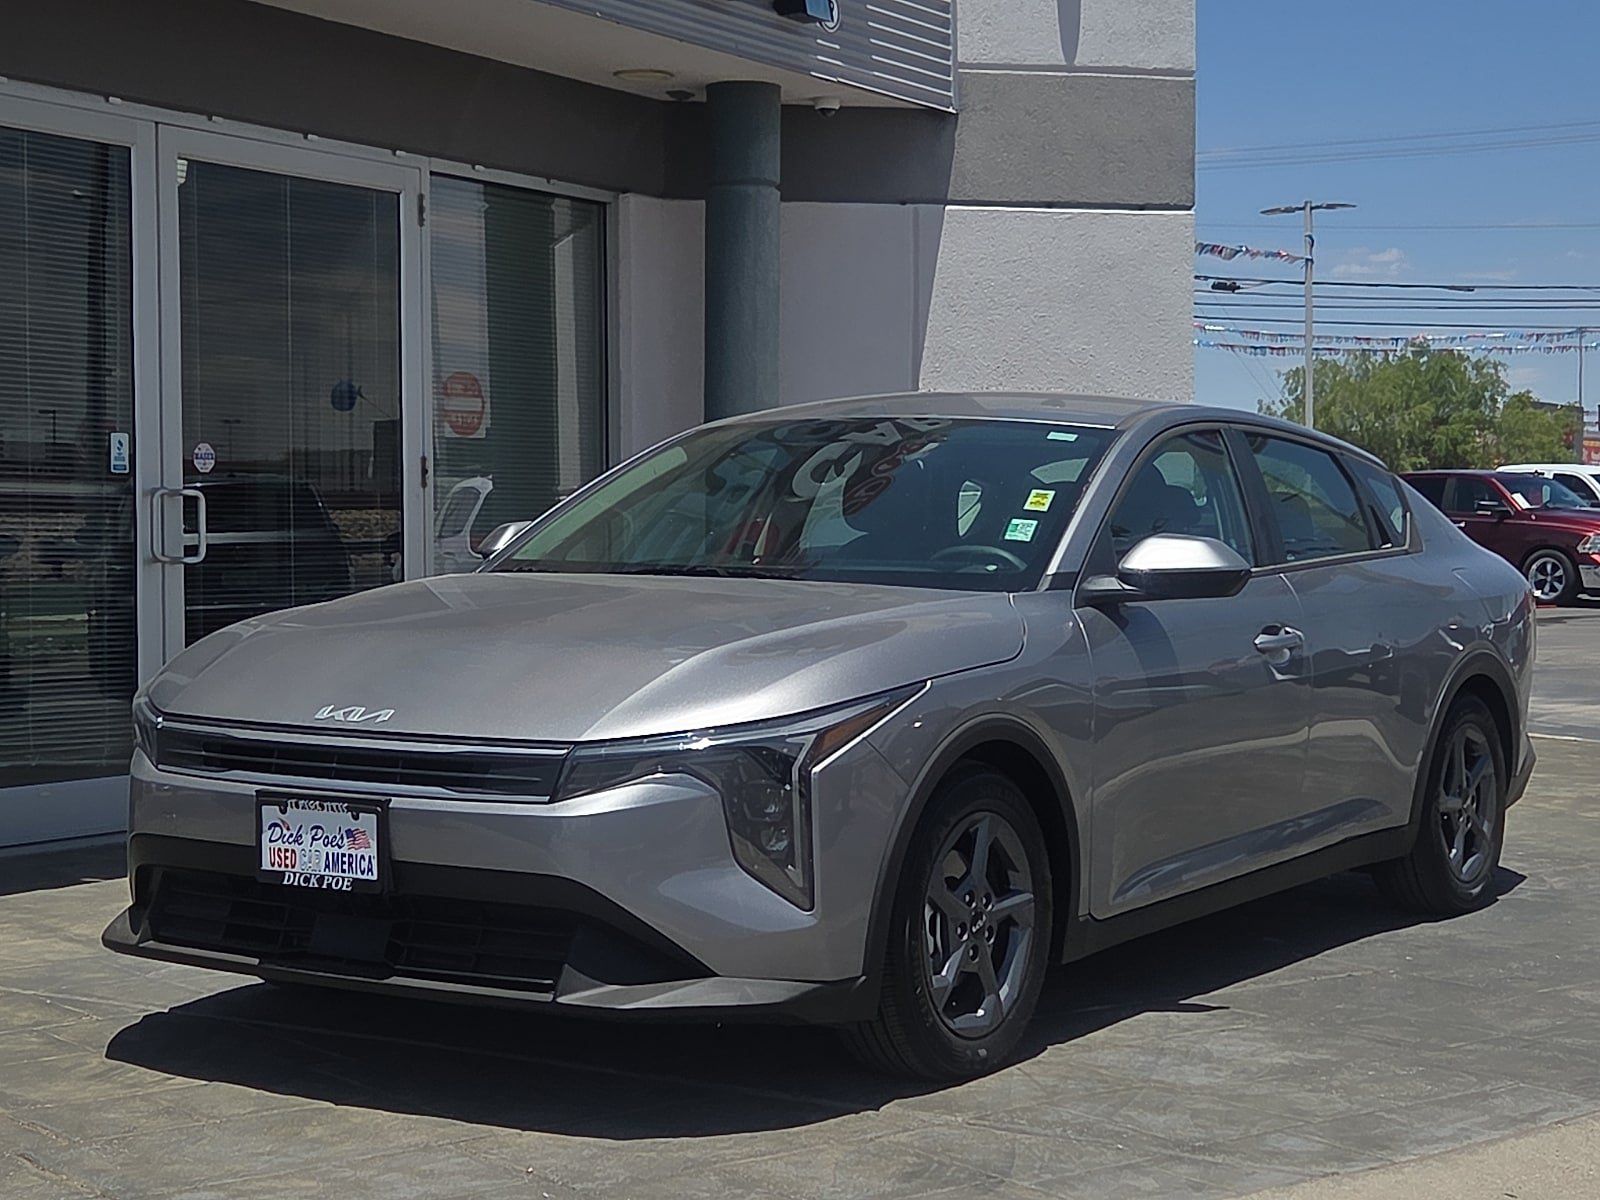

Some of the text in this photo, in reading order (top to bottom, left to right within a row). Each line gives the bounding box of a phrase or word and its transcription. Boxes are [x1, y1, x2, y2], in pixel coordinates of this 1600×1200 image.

[314, 704, 395, 723] KIA
[268, 822, 346, 850] Dick Poe's
[269, 846, 297, 869] USED
[324, 851, 374, 877] AMERICA
[282, 872, 354, 892] DICK POE
